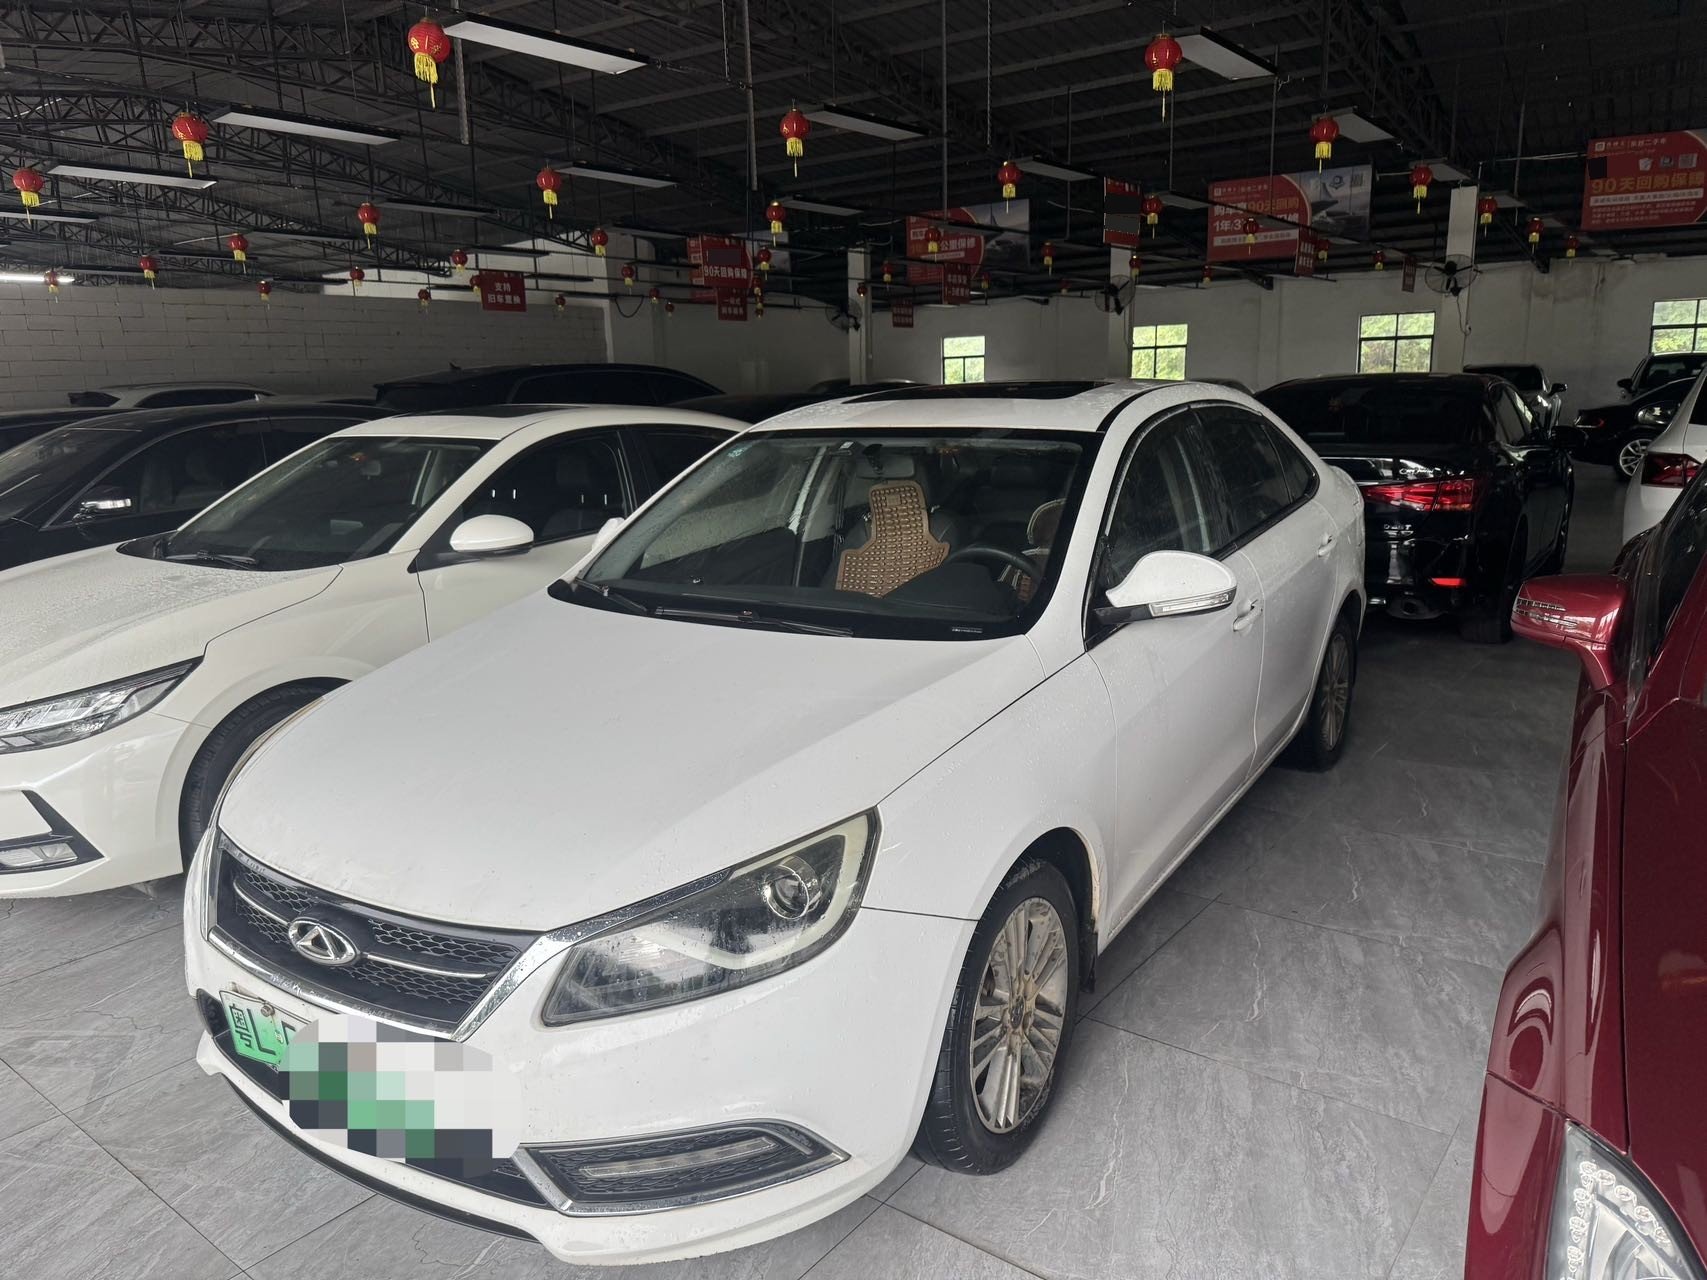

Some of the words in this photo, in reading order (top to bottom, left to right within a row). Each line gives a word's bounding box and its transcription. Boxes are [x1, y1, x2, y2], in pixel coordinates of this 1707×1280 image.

[703, 265, 747, 279] 90天回购保障
[495, 282, 511, 293] 支持
